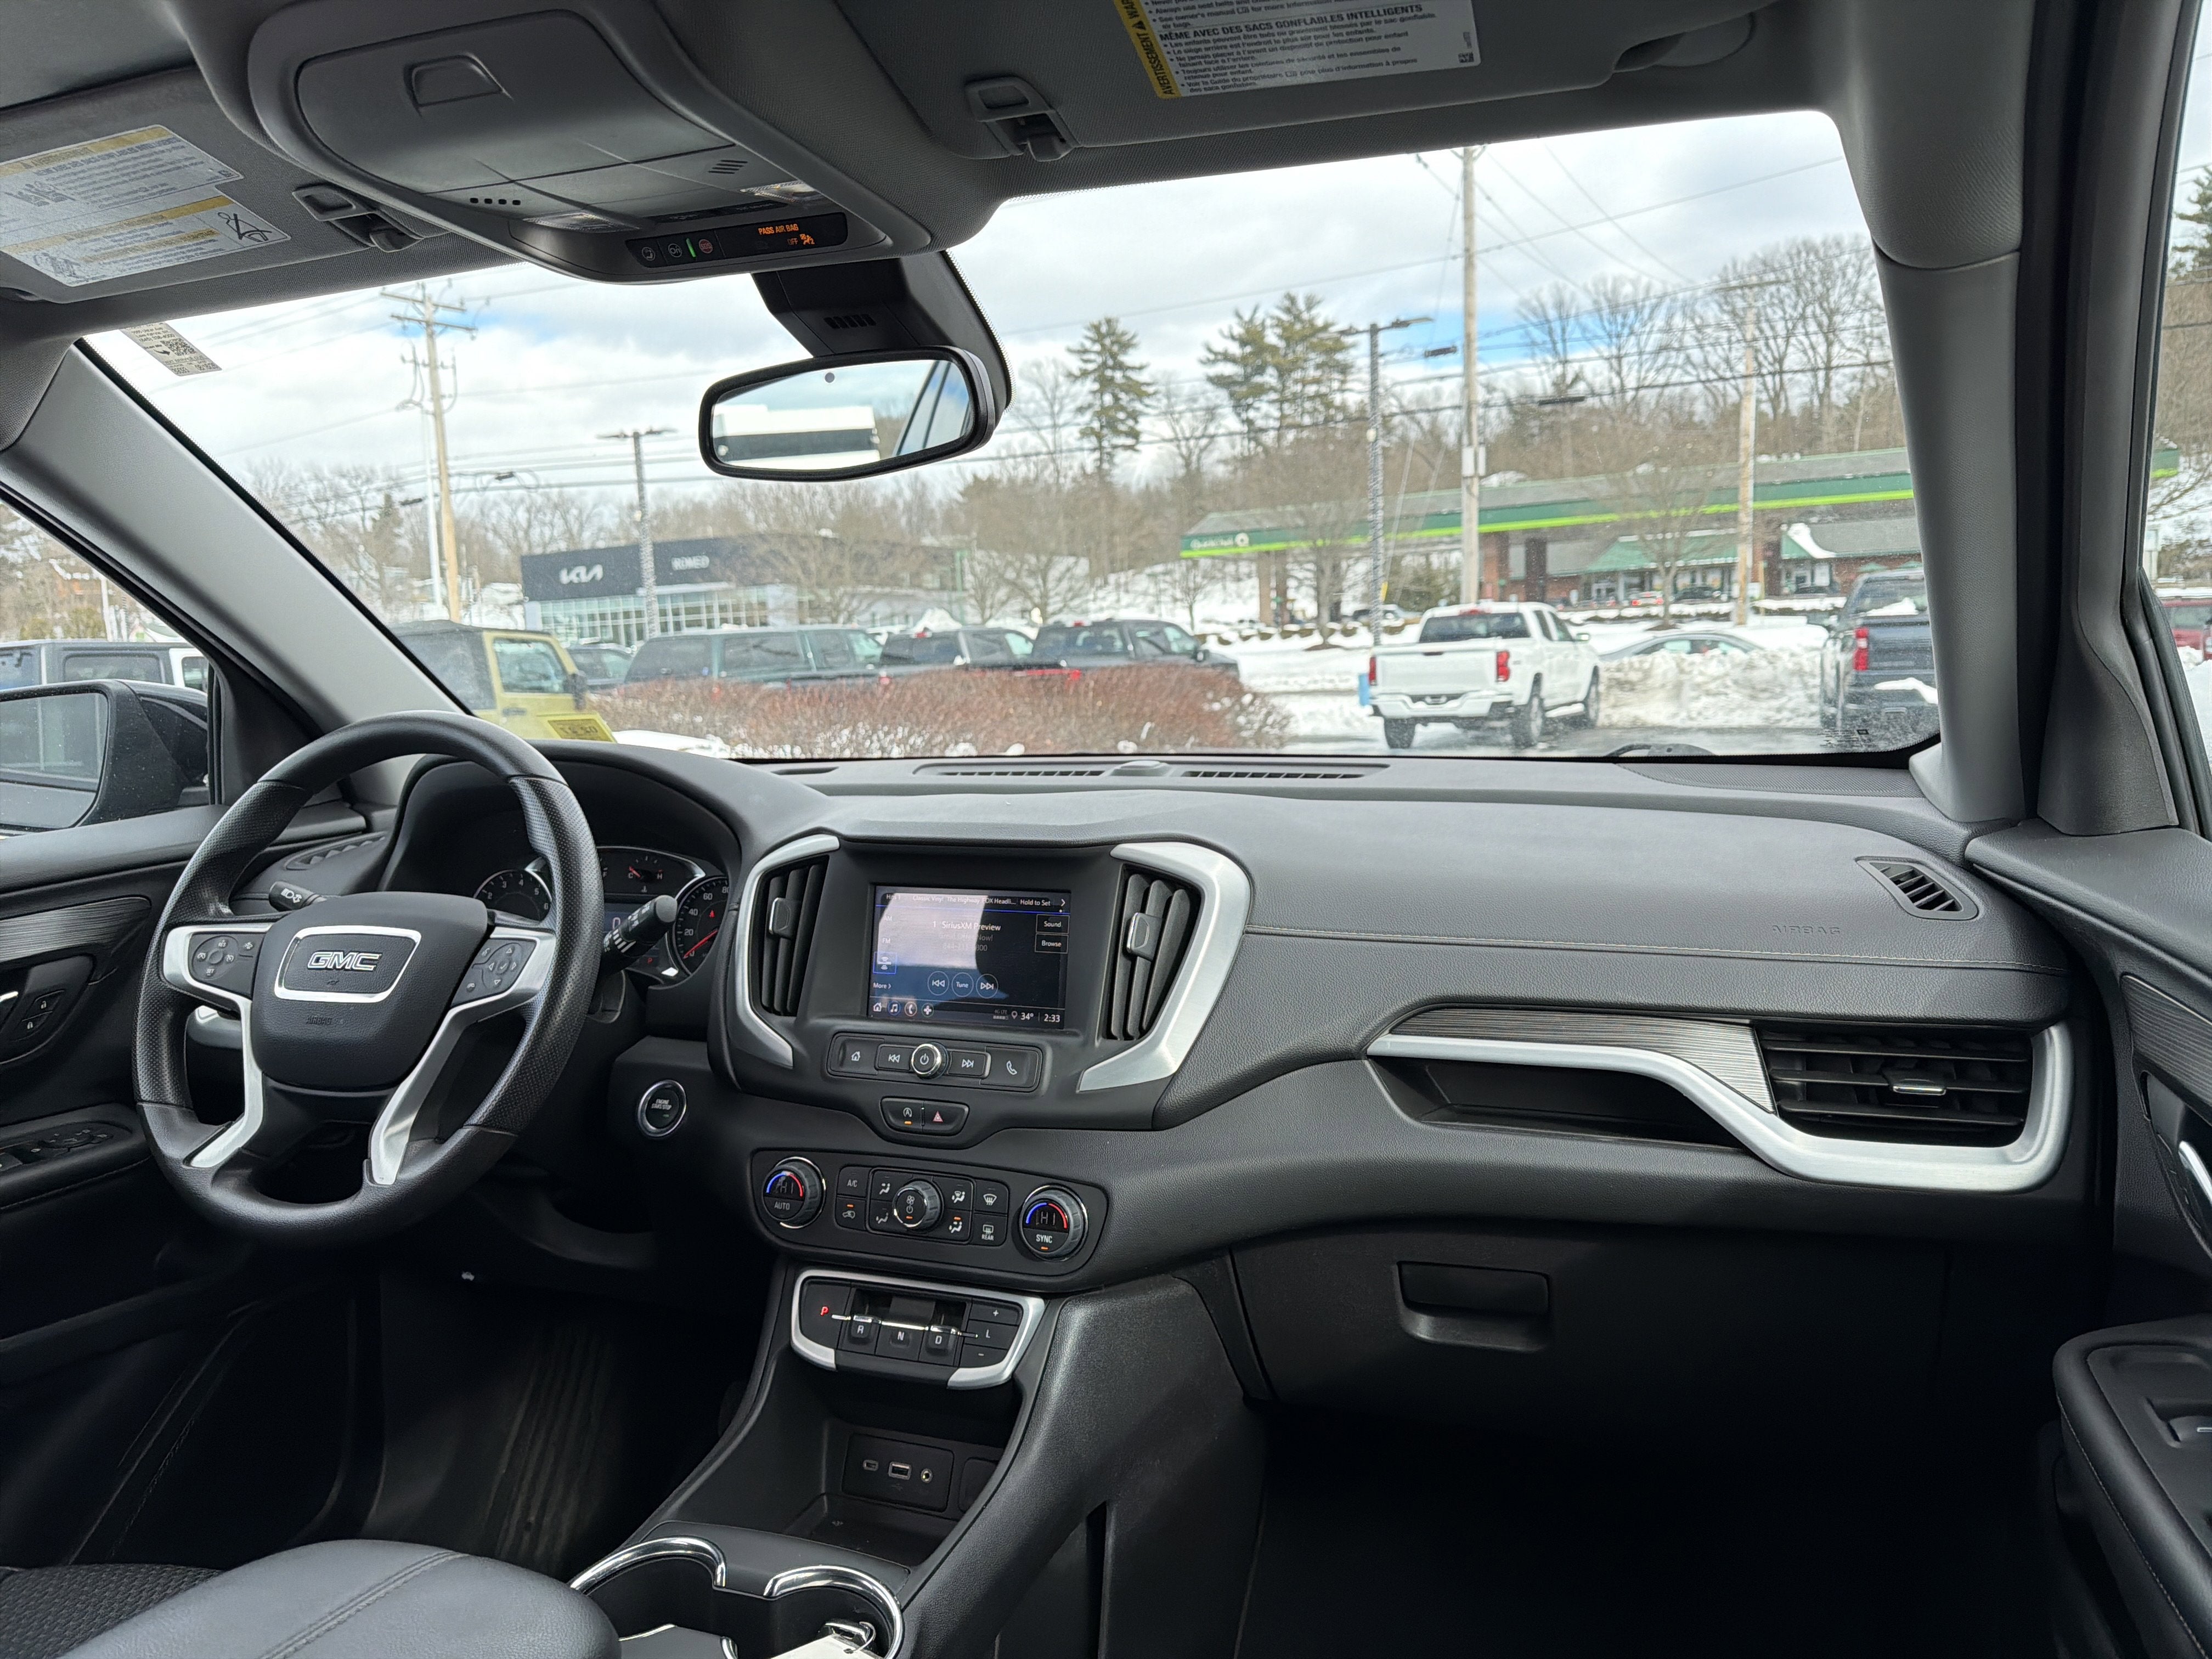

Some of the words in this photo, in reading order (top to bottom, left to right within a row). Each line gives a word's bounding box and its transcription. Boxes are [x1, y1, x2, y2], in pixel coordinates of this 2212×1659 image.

[1193, 27, 1220, 38] AVEC
[1221, 25, 1243, 35] DES
[1244, 22, 1273, 32] SACS
[1275, 13, 1344, 29] GONFLABLES
[1346, 3, 1423, 21] INTELLIGENTS
[758, 227, 775, 235] PASS
[776, 225, 787, 233] AIR
[786, 223, 799, 232] BAG
[672, 555, 709, 571] ROMEO
[502, 881, 507, 889] 3
[487, 891, 493, 900] 2
[534, 887, 539, 895] 5
[941, 921, 973, 930] SiriusXM
[973, 922, 1001, 931] Preview
[1043, 920, 1062, 928] Sound
[1771, 924, 1841, 934] AIRBAG
[1041, 940, 1062, 948] Browse
[307, 951, 383, 971] GMC
[1043, 1014, 1061, 1023] 2:33
[847, 1179, 857, 1189] A/C
[774, 1201, 791, 1211] AUTO
[1035, 1233, 1053, 1244] SYNC
[820, 1306, 830, 1316] P
[857, 1325, 864, 1334] R
[985, 1329, 991, 1339] L
[897, 1331, 904, 1341] N
[935, 1335, 942, 1345] D
